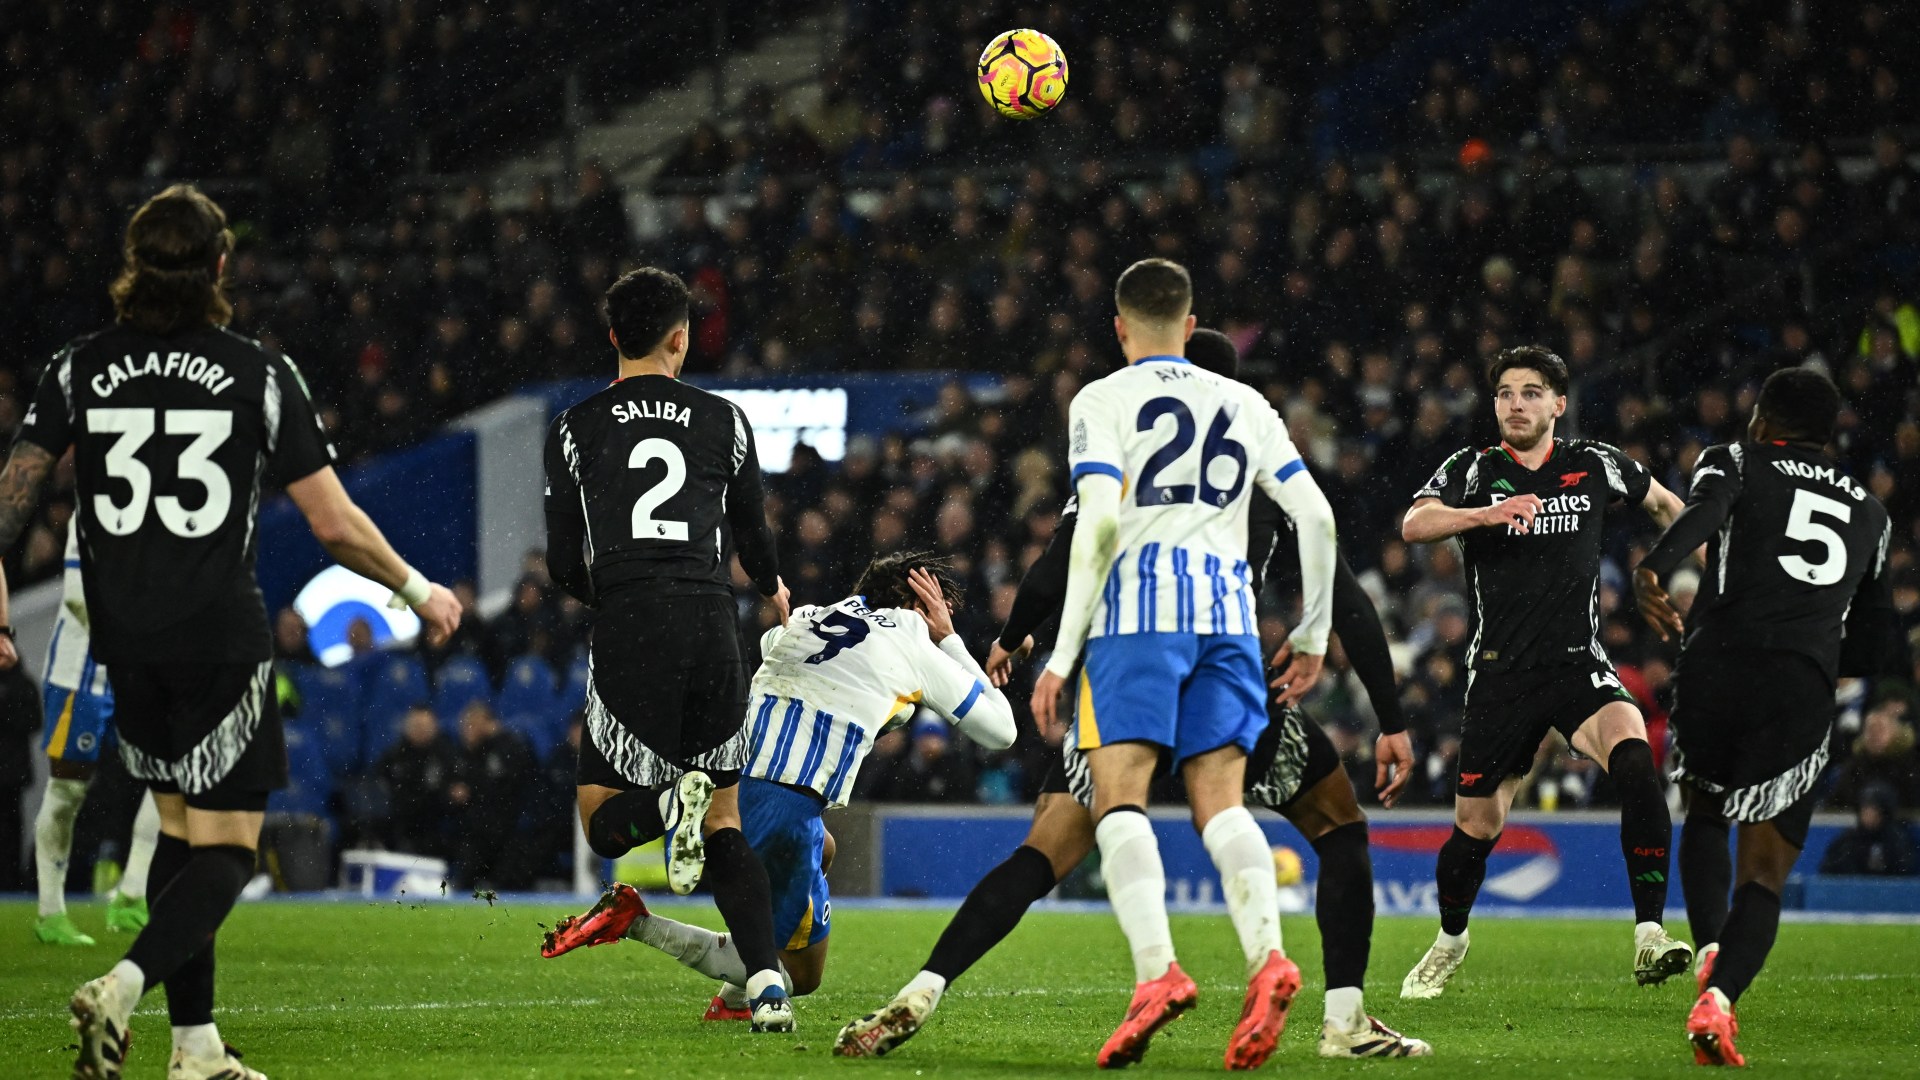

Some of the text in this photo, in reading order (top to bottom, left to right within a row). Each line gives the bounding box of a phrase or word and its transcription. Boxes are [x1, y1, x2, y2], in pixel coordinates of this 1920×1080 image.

[91, 352, 235, 398] CALAFIORI
[611, 400, 692, 428] SALIBA
[86, 408, 233, 538] 33
[1135, 396, 1248, 509] 26
[628, 437, 690, 541] 2
[1490, 492, 1591, 515] Erates
[1771, 459, 1867, 501] THOMAS
[1533, 514, 1579, 535] BETTER
[1777, 488, 1851, 586] 5
[803, 609, 871, 665] 9
